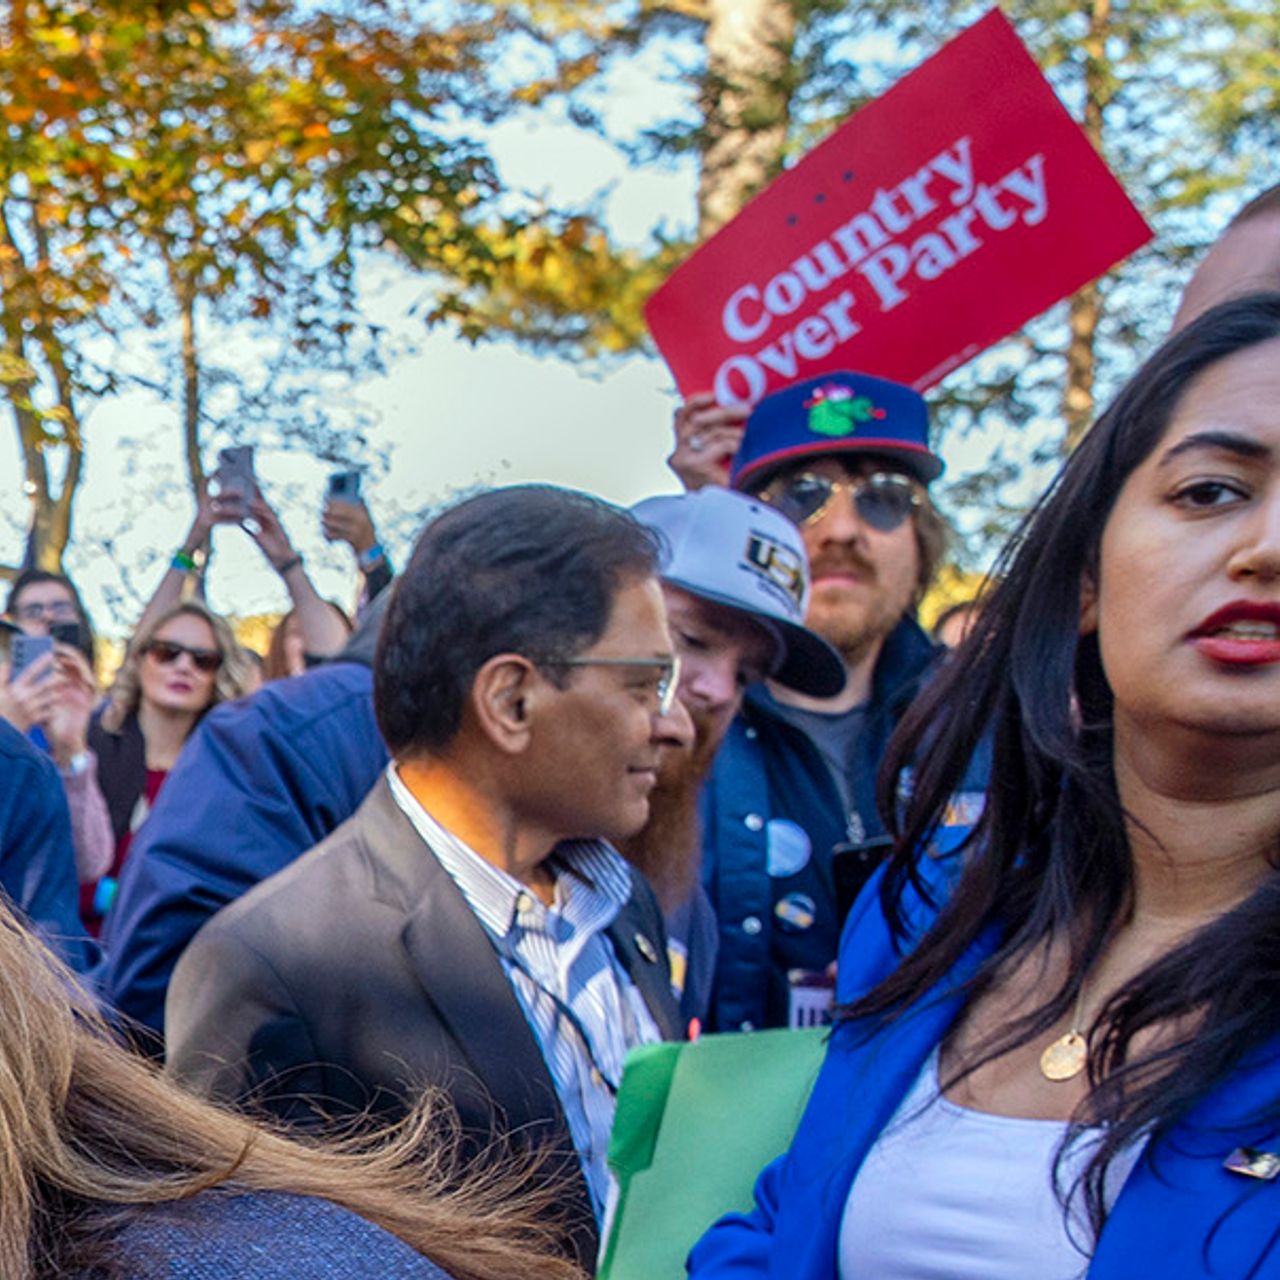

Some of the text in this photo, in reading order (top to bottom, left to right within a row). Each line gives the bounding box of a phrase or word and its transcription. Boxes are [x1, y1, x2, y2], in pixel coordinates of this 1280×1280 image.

[713, 152, 1049, 410] Over Party
[721, 135, 974, 343] Country
